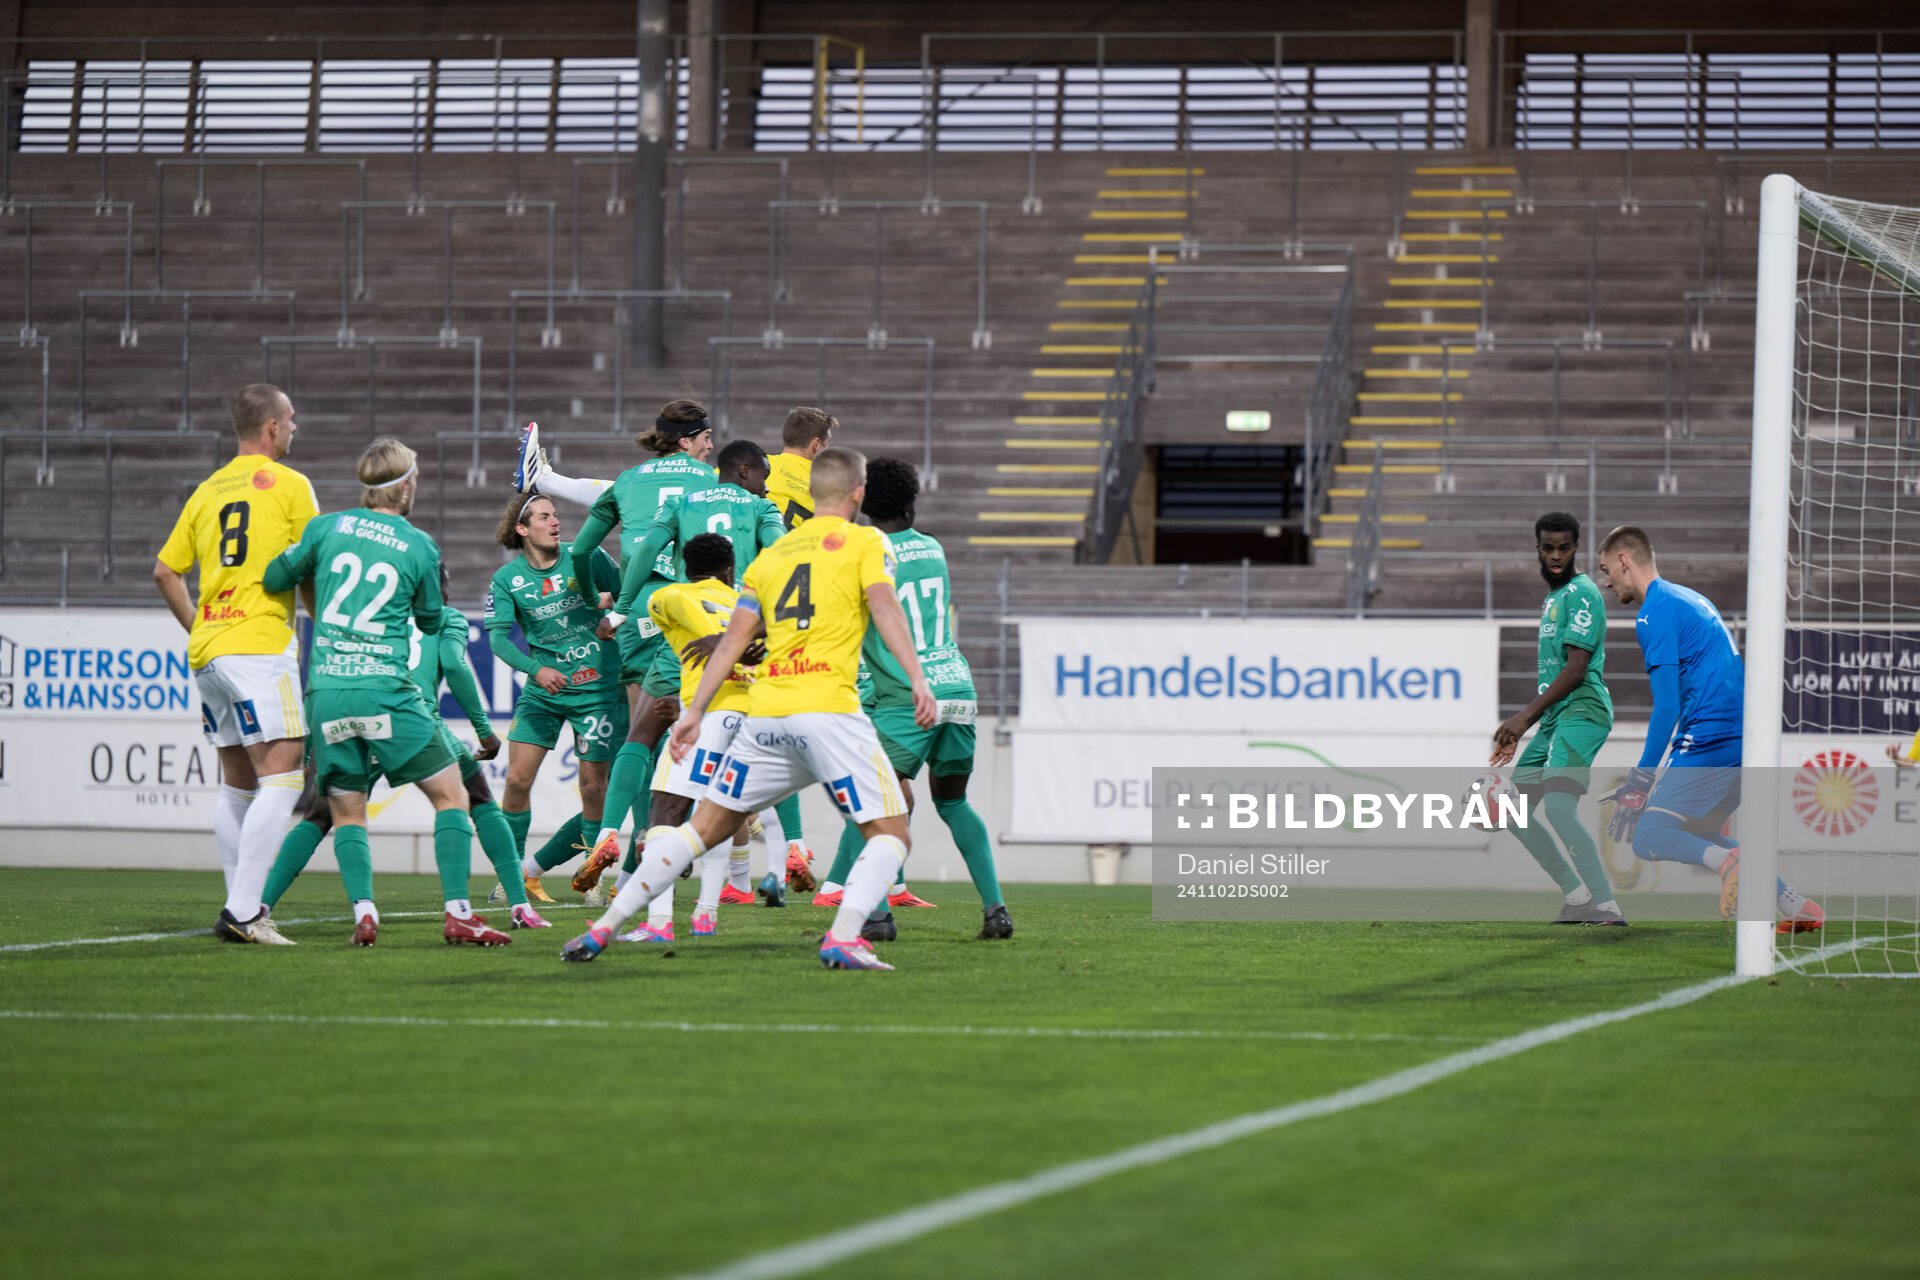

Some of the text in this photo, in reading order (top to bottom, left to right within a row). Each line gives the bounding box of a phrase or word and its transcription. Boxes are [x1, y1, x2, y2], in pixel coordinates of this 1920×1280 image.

[218, 500, 251, 568] 8
[358, 517, 396, 537] KAKEL
[320, 551, 400, 636] 22
[774, 562, 816, 631] 4
[897, 576, 945, 651] 17
[24, 648, 189, 680] PETERSON
[314, 664, 397, 677] WELLNESS
[1839, 652, 1894, 669] LIVET
[1055, 654, 1463, 701] Handelsbanken
[1792, 671, 1832, 691] FÖR
[1837, 675, 1874, 691] ATT
[1883, 700, 1910, 716] EN
[329, 716, 367, 736] akea
[583, 715, 614, 742] 26
[90, 743, 222, 785] OCEA
[136, 792, 192, 806] HOTEL
